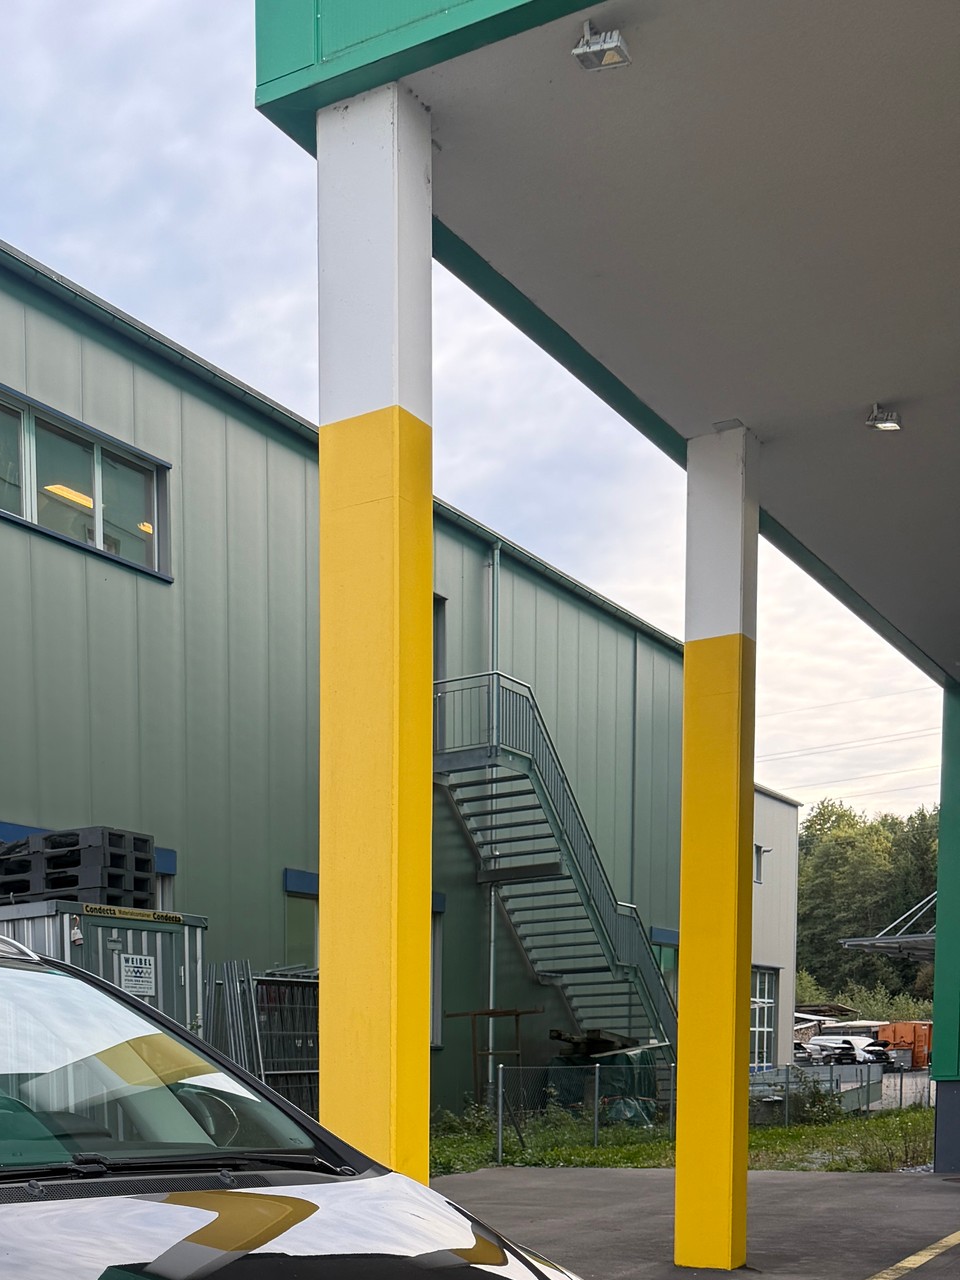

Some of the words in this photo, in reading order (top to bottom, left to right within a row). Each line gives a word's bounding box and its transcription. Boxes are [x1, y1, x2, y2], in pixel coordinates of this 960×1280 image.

[85, 905, 116, 915] Condecta
[152, 912, 181, 922] Condecta
[124, 956, 152, 966] WEIBEL
